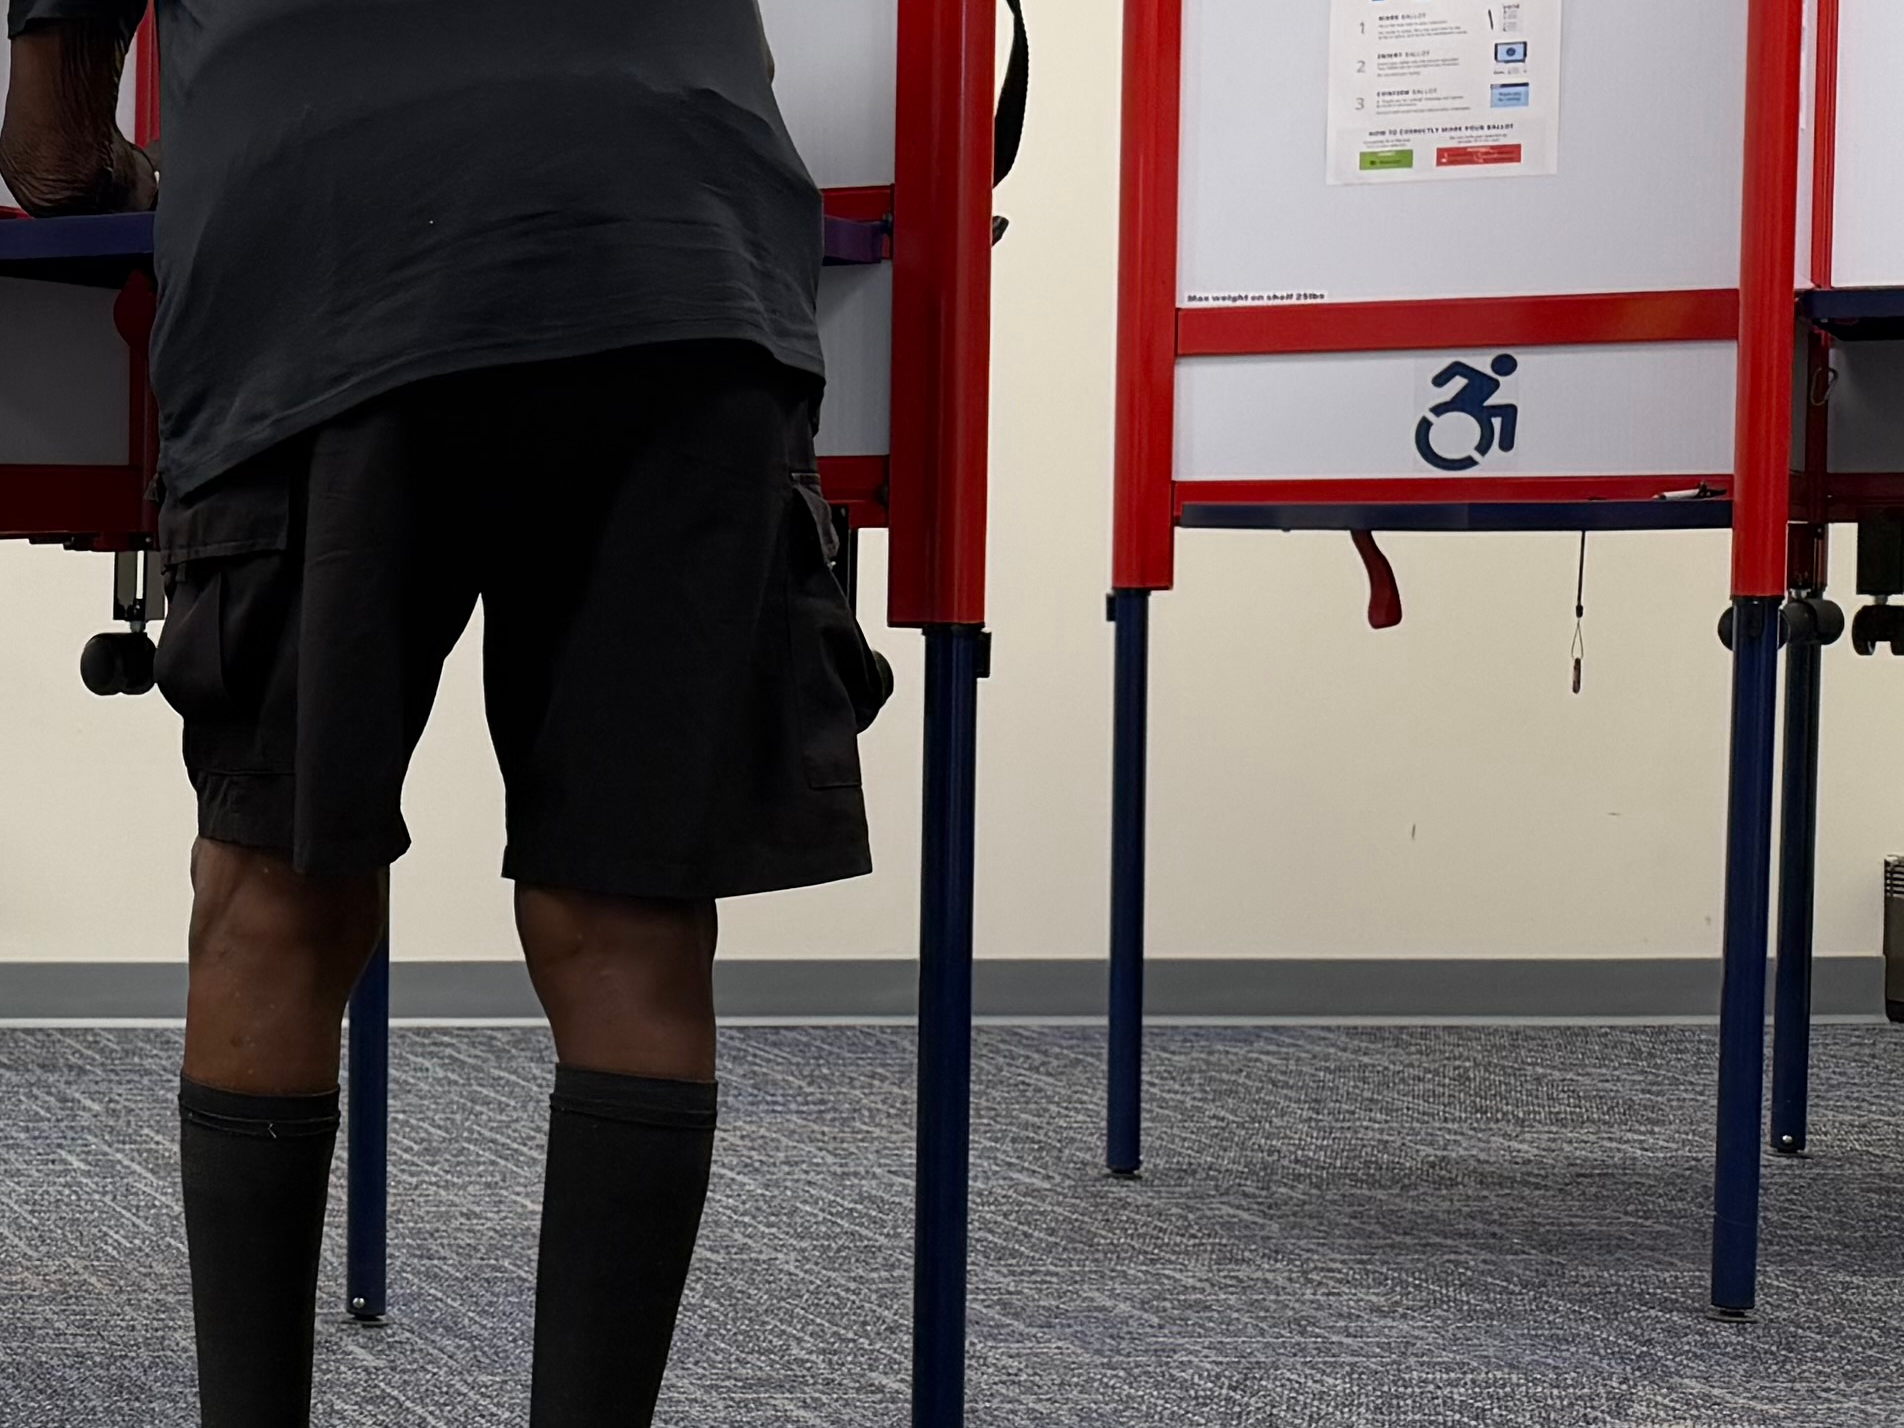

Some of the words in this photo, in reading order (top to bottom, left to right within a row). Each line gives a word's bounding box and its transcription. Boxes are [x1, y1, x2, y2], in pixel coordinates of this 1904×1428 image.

[1359, 21, 1365, 35] 1
[1356, 60, 1366, 73] 2
[1355, 98, 1365, 110] 3
[1187, 294, 1209, 302] Max
[1212, 294, 1248, 303] weight
[1267, 293, 1293, 301] shelf
